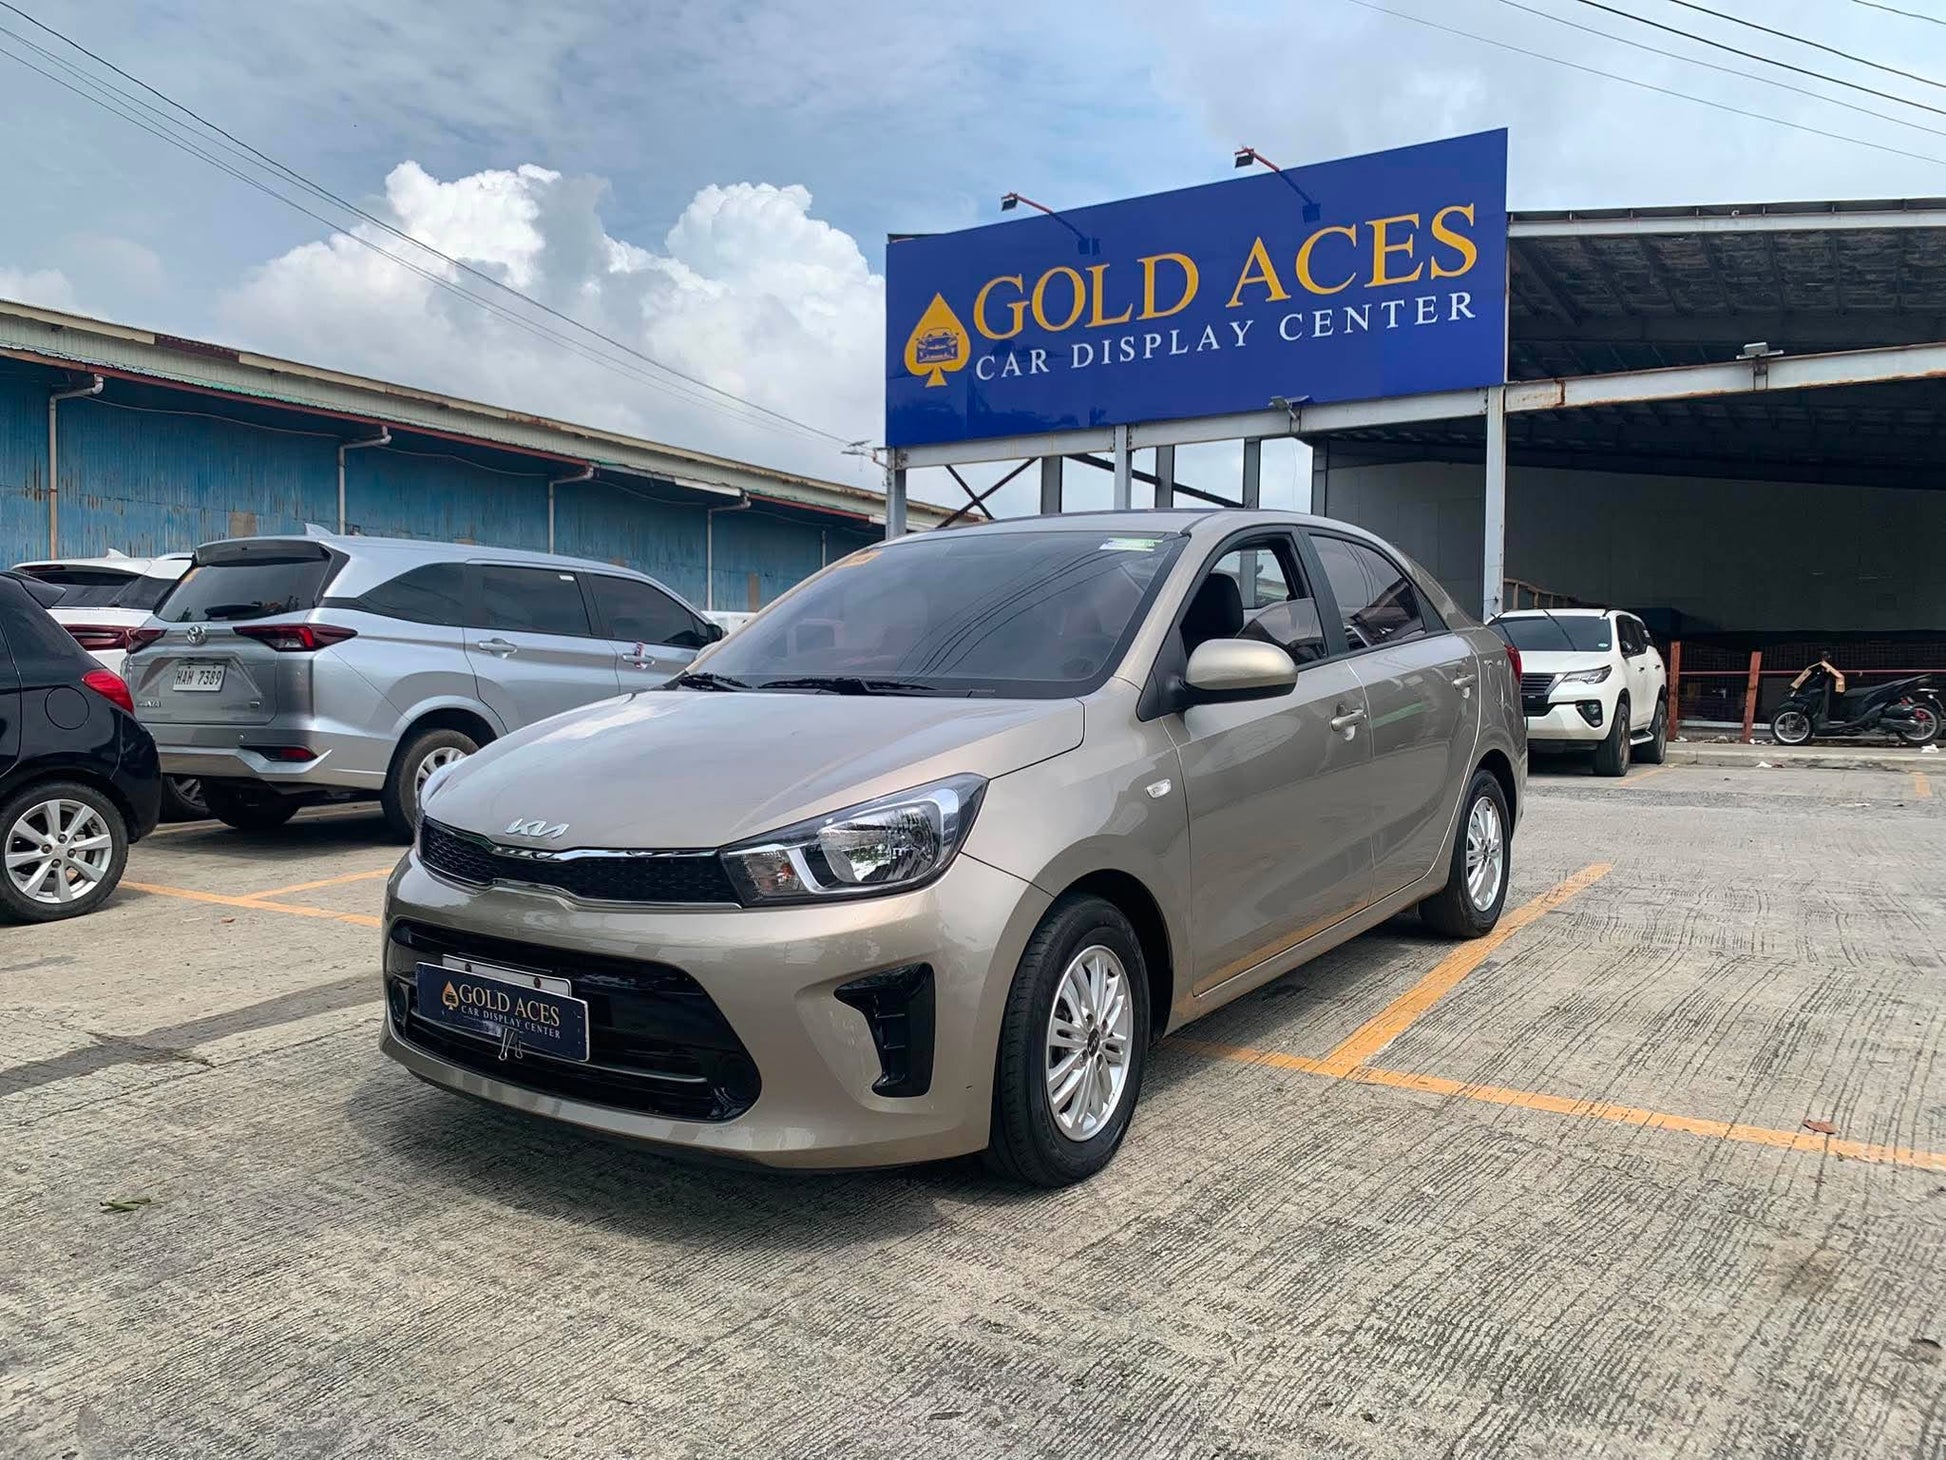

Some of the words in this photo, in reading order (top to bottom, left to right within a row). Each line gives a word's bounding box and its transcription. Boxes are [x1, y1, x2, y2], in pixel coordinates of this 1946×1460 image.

[973, 252, 1200, 341] GOLD
[1225, 202, 1478, 308] ACES
[975, 349, 1050, 381] CAR
[1070, 320, 1256, 370] DISPLAY
[1279, 291, 1477, 341] CENTER
[505, 818, 569, 840] KIA
[459, 984, 510, 1012] GOLD
[514, 997, 560, 1027] ACES
[461, 1005, 480, 1017] CAR
[483, 1011, 522, 1027] DISPLAY
[525, 1021, 561, 1039] CENTER
